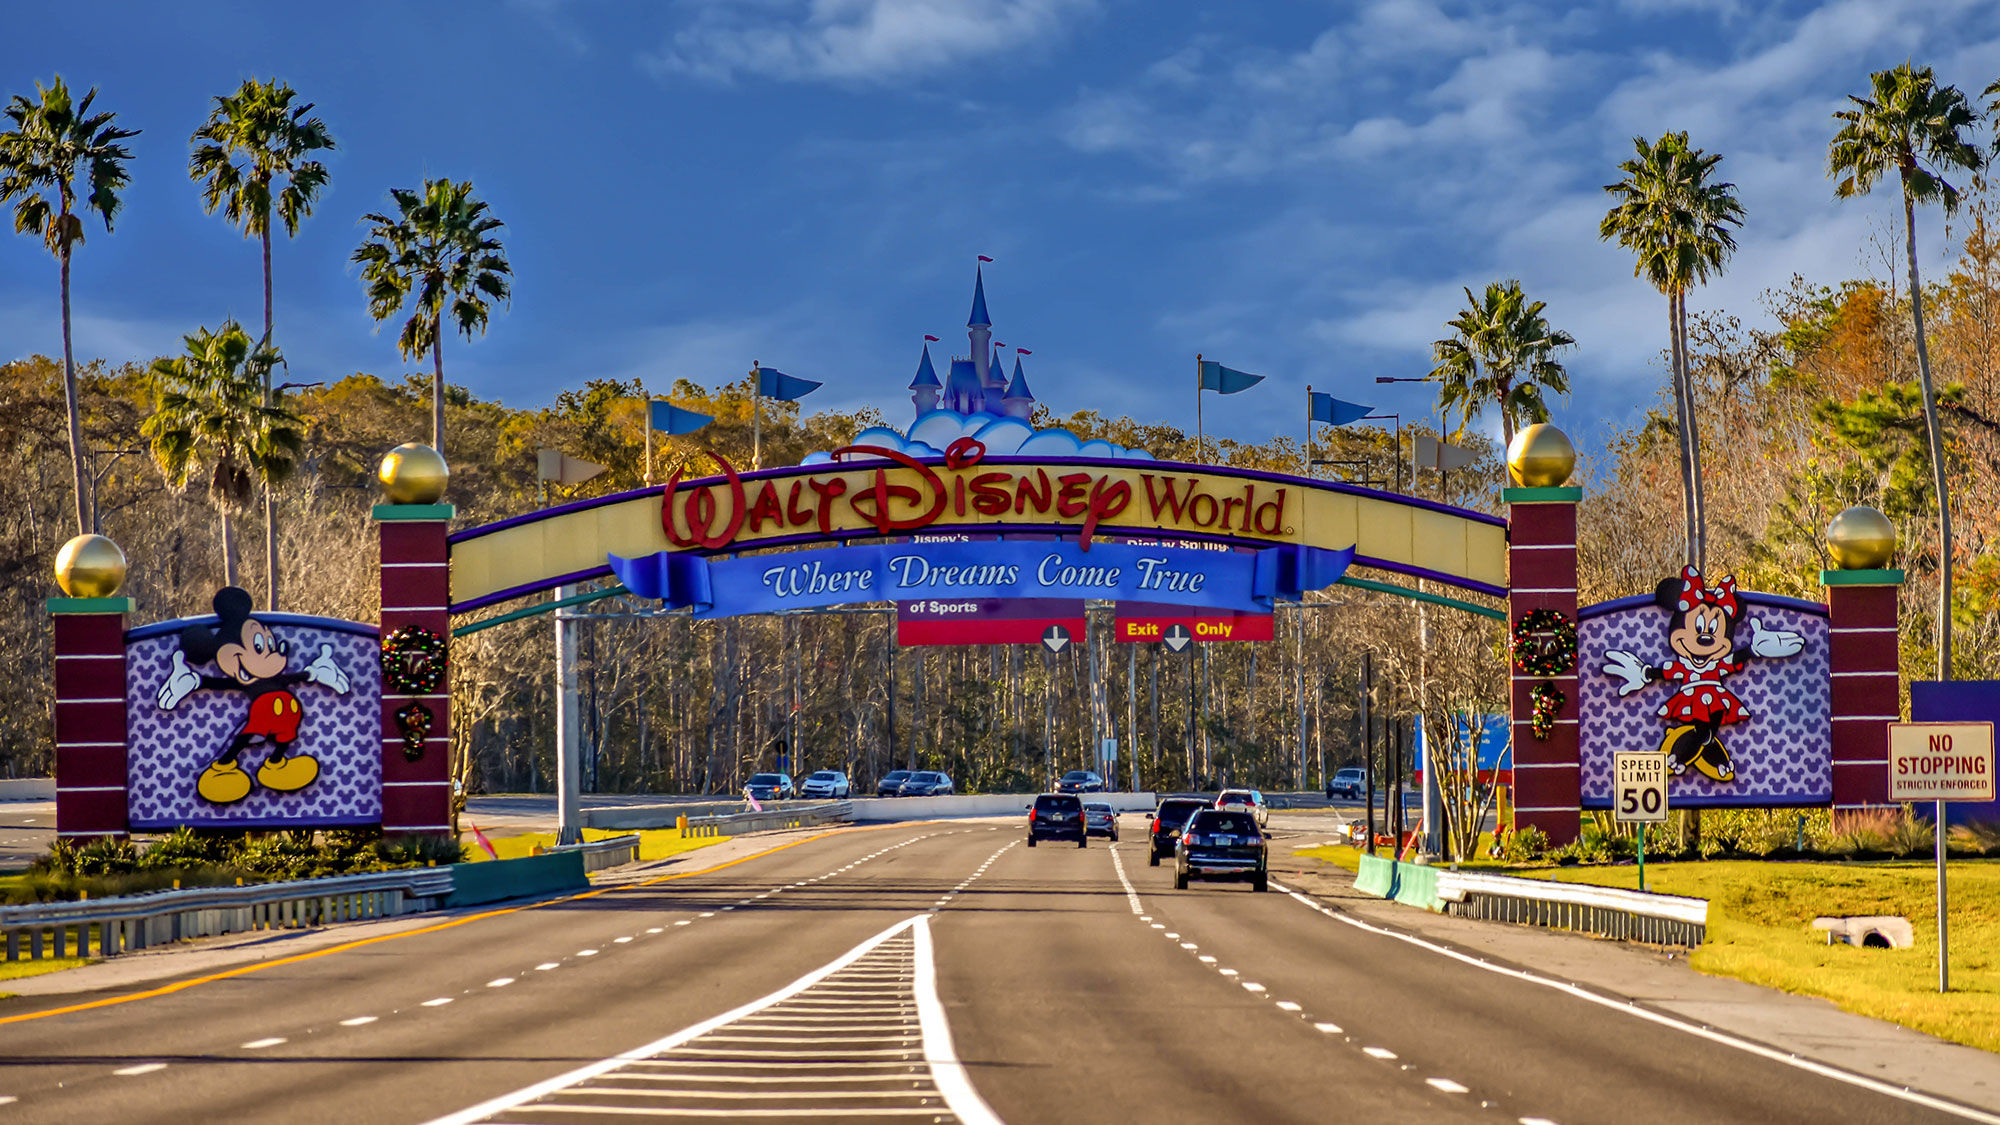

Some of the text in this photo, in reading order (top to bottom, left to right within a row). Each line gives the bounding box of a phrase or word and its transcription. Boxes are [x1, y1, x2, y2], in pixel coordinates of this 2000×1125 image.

[763, 553, 1206, 598] Where Dreams Come True
[909, 601, 978, 615] of Sports
[1127, 622, 1233, 638] Exit Only
[1928, 734, 1953, 753] NO
[1621, 759, 1661, 770] SPEED
[1897, 755, 1986, 775] STOPPING
[1621, 771, 1661, 782] LIMIT
[1896, 779, 1988, 790] STRICTLY ENFORCED
[1621, 787, 1662, 815] 50
